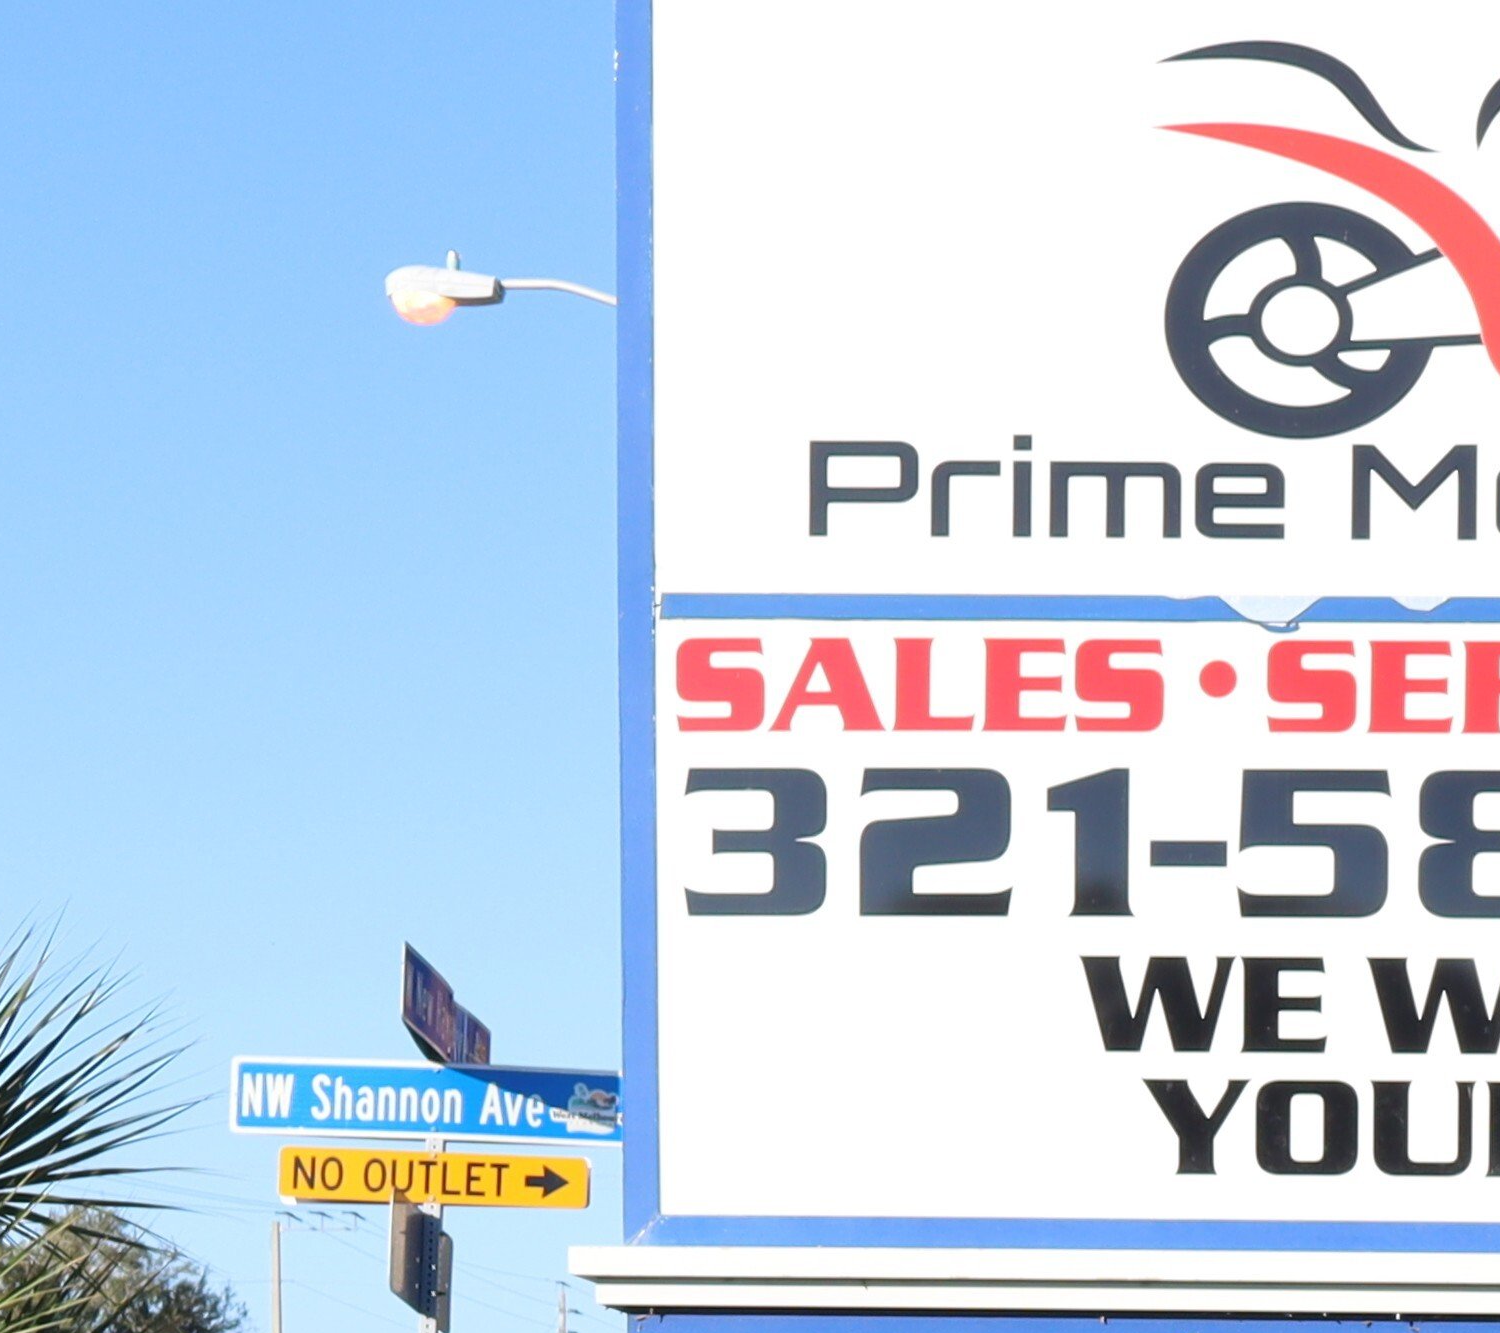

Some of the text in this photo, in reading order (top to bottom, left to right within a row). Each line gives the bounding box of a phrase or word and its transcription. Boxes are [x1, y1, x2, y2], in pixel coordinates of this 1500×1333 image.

[808, 435, 1285, 539] Prime
[677, 637, 1165, 733] SALES
[1080, 956, 1327, 1054] WE
[240, 1072, 545, 1128] NW Shannon Ave
[292, 1156, 510, 1197] NO OUTLET
